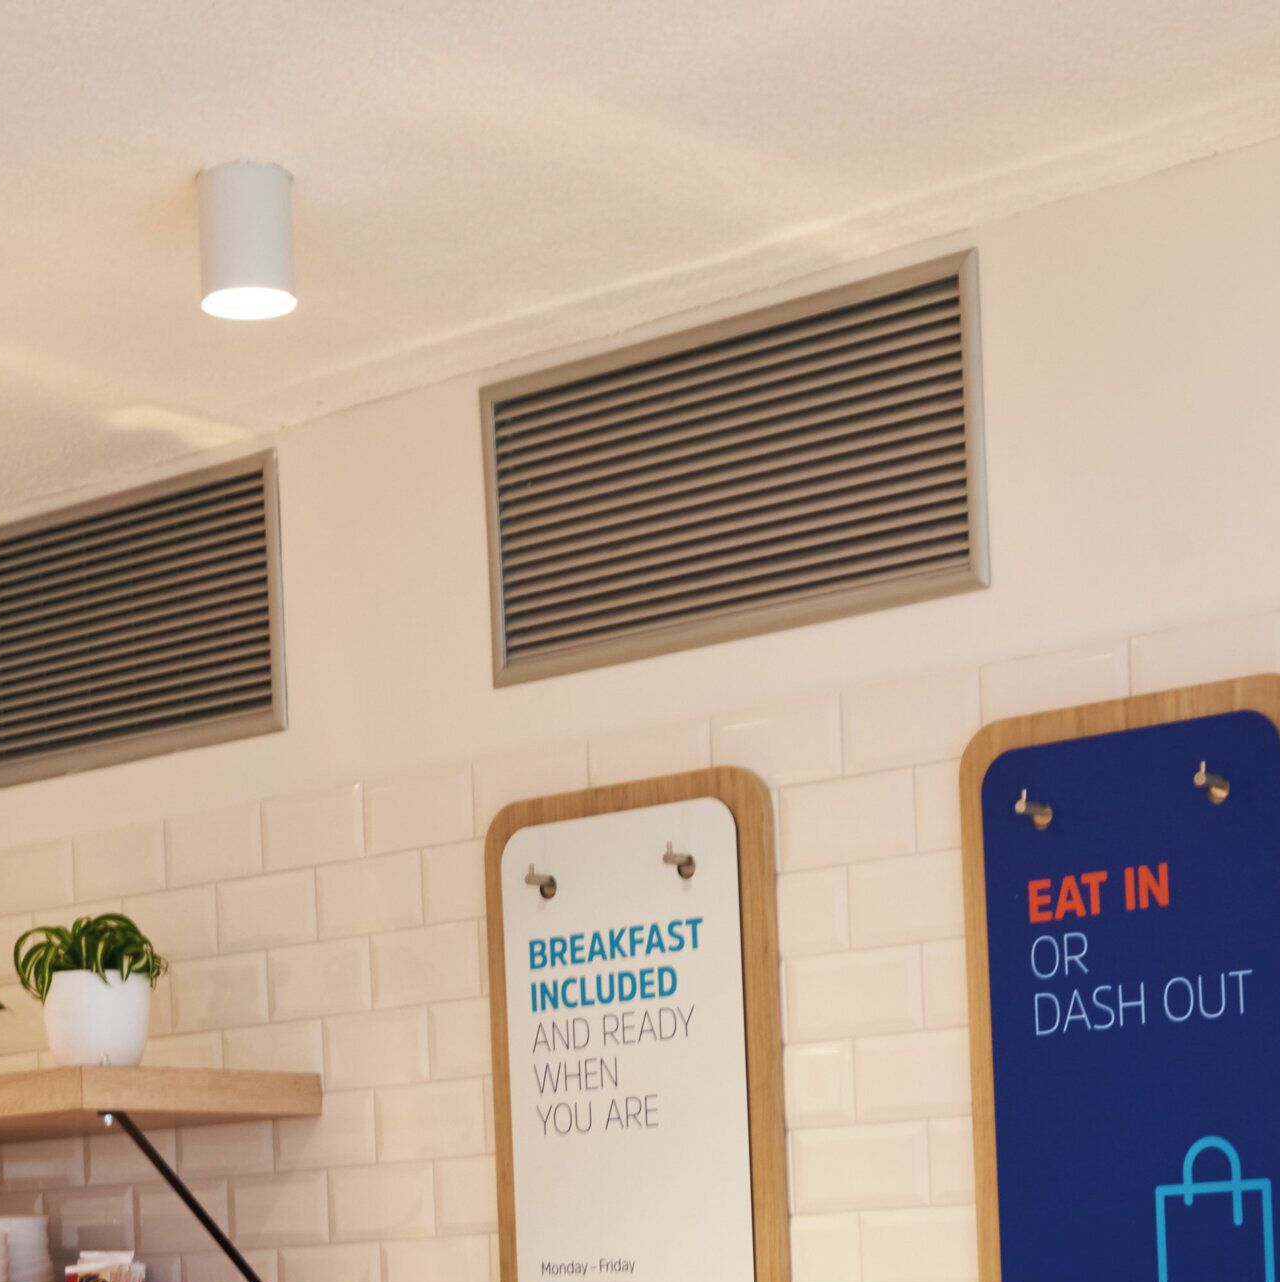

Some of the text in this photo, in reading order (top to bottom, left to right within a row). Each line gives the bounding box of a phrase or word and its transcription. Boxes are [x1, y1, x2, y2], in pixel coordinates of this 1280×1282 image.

[1028, 861, 1170, 924] EAT IN
[528, 916, 703, 970] BREAKFAST
[1030, 932, 1089, 980] OR
[530, 965, 678, 1013] INCLUDED
[1034, 969, 1253, 1036] DASH OUT
[532, 1004, 695, 1054] AND READY
[533, 1056, 619, 1095] WHEN
[536, 1094, 660, 1137] YOU ARE
[541, 1260, 588, 1276] Monday
[599, 1258, 636, 1275] Friday
